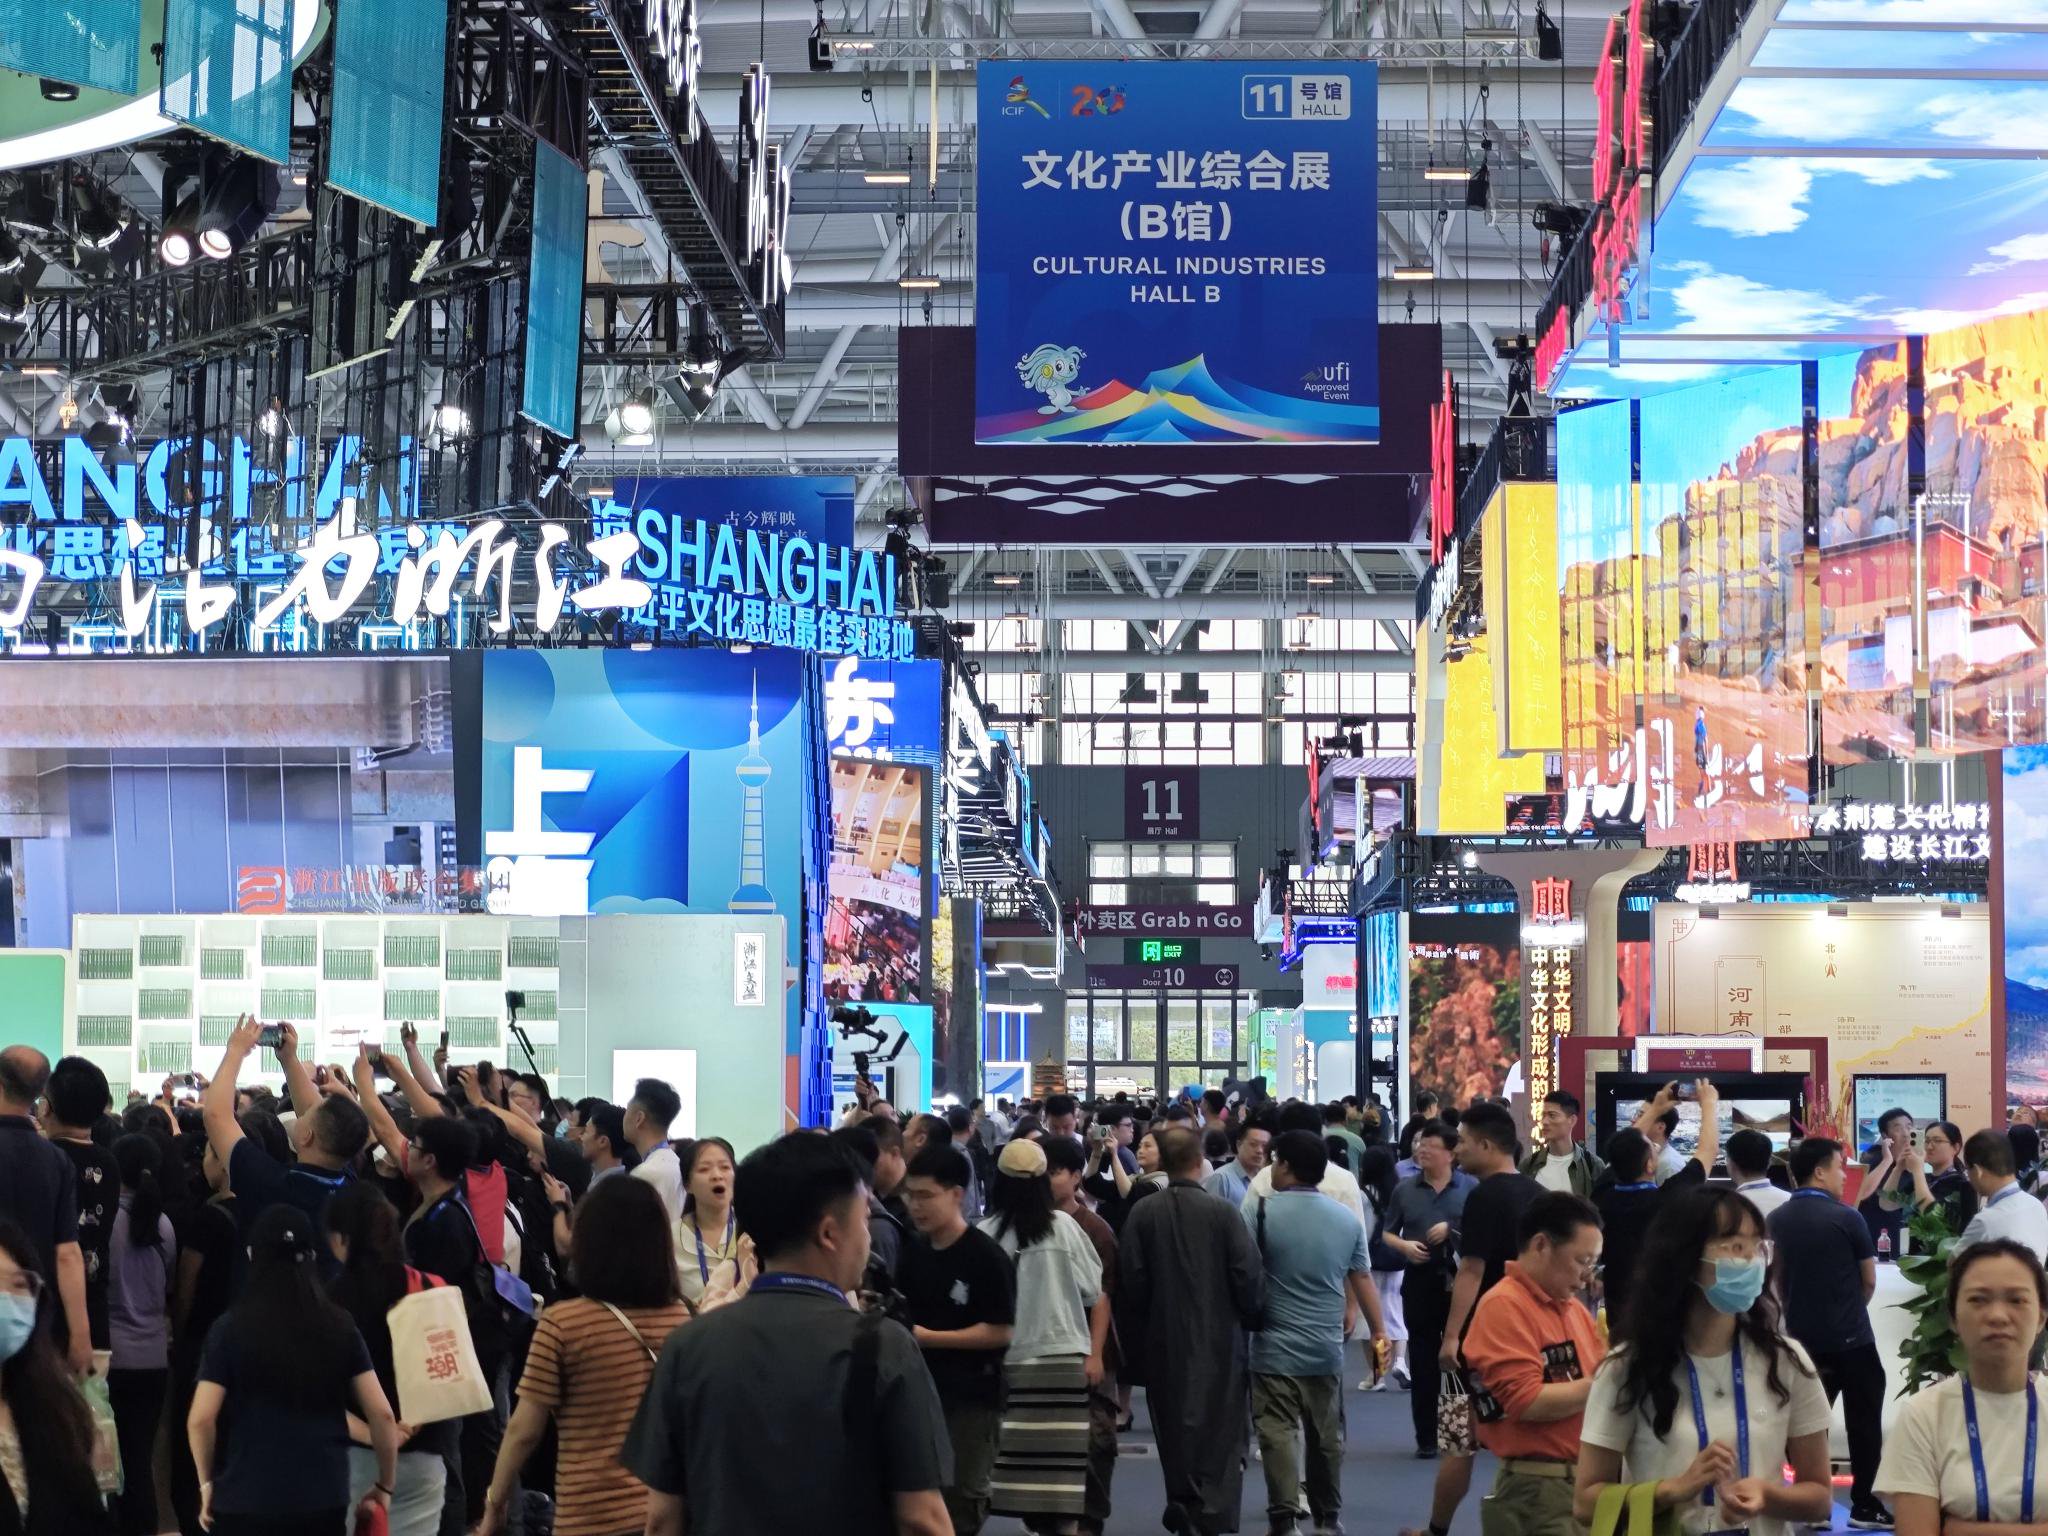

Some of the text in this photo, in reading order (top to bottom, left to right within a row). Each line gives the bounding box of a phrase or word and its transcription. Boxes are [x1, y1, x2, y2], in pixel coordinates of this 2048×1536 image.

[1250, 84, 1283, 112] 11
[1300, 82, 1342, 101] 号馆
[1002, 106, 1025, 116] ICIF
[1302, 104, 1342, 116] HALL
[1021, 149, 1331, 191] 文化产业综合展
[1032, 256, 1327, 276] CULTURAL INDUSTRIES
[1130, 285, 1221, 304] HALL B
[1324, 361, 1350, 382] ufi
[1304, 382, 1350, 393] Approved
[1323, 391, 1350, 401] Event
[724, 510, 797, 527] 古今辉映
[635, 508, 897, 618] SHANGHAI
[622, 583, 915, 664] 近平文化思想最佳实践地
[1142, 780, 1183, 821] 11
[1165, 827, 1178, 835] Hall
[1080, 910, 1242, 930] 外卖区 Grab n Go
[1825, 943, 1836, 953] 北
[1164, 968, 1185, 986] 10
